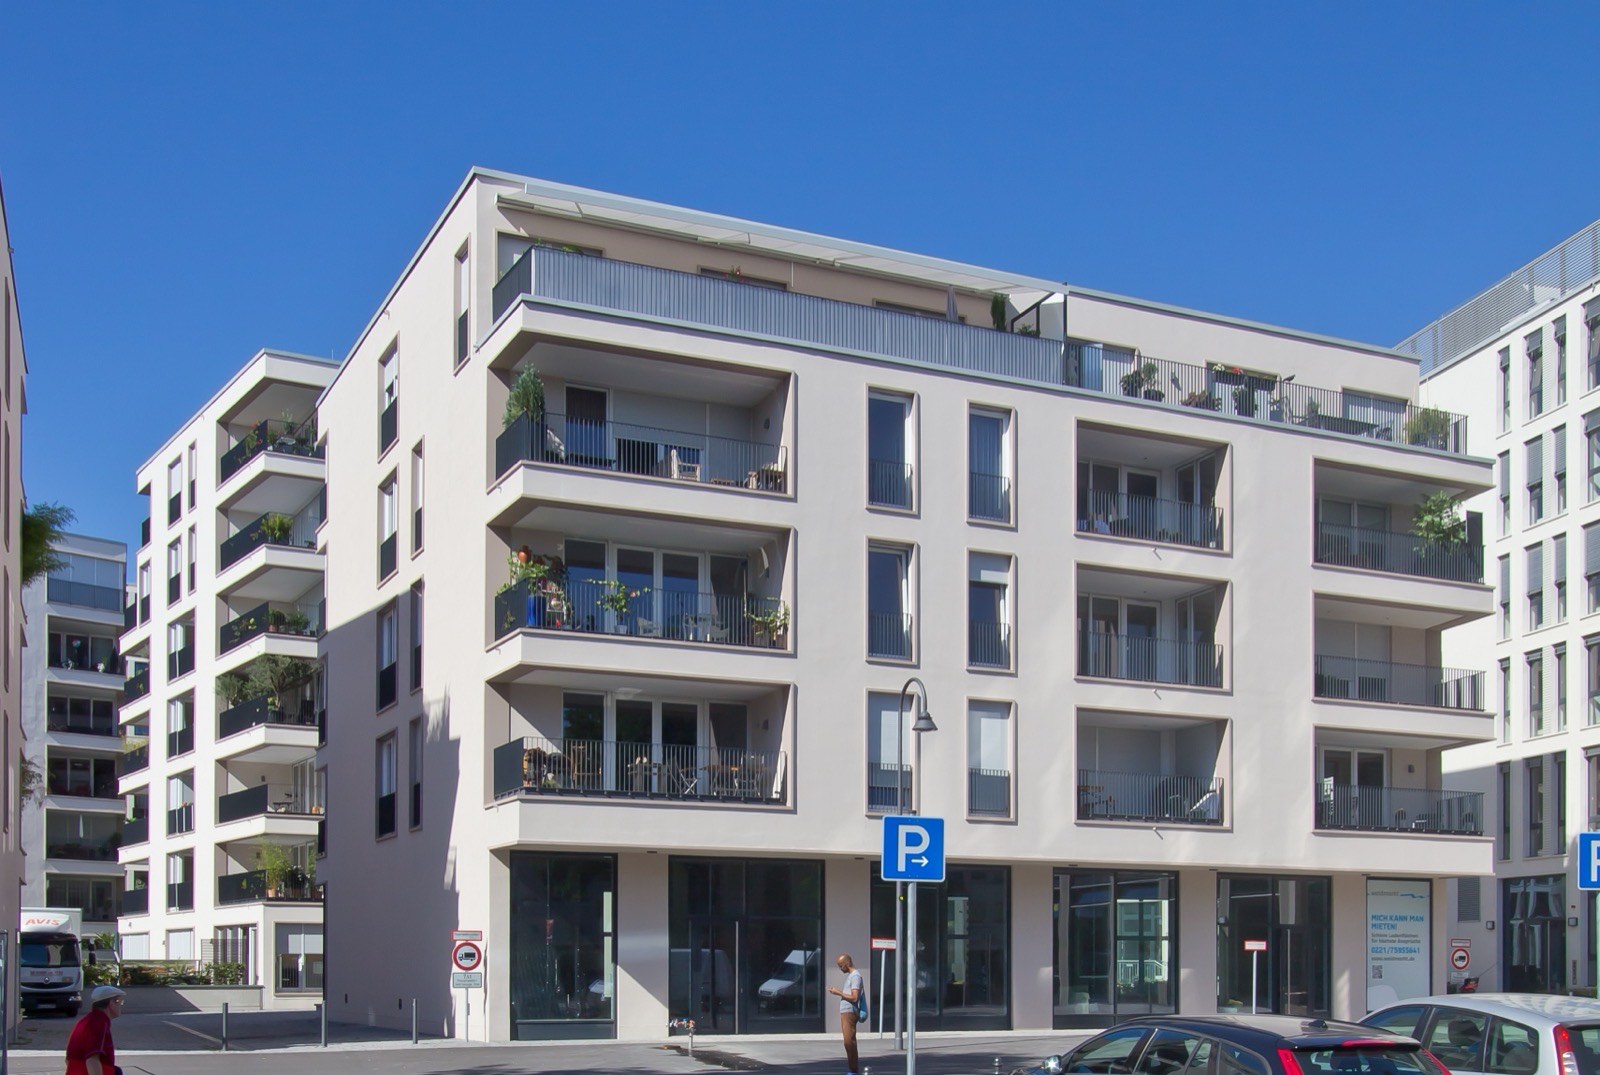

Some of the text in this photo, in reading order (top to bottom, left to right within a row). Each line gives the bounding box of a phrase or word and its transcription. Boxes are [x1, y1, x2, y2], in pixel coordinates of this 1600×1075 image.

[897, 824, 931, 872] P
[25, 917, 60, 926] AVIS
[1389, 914, 1408, 922] KANN
